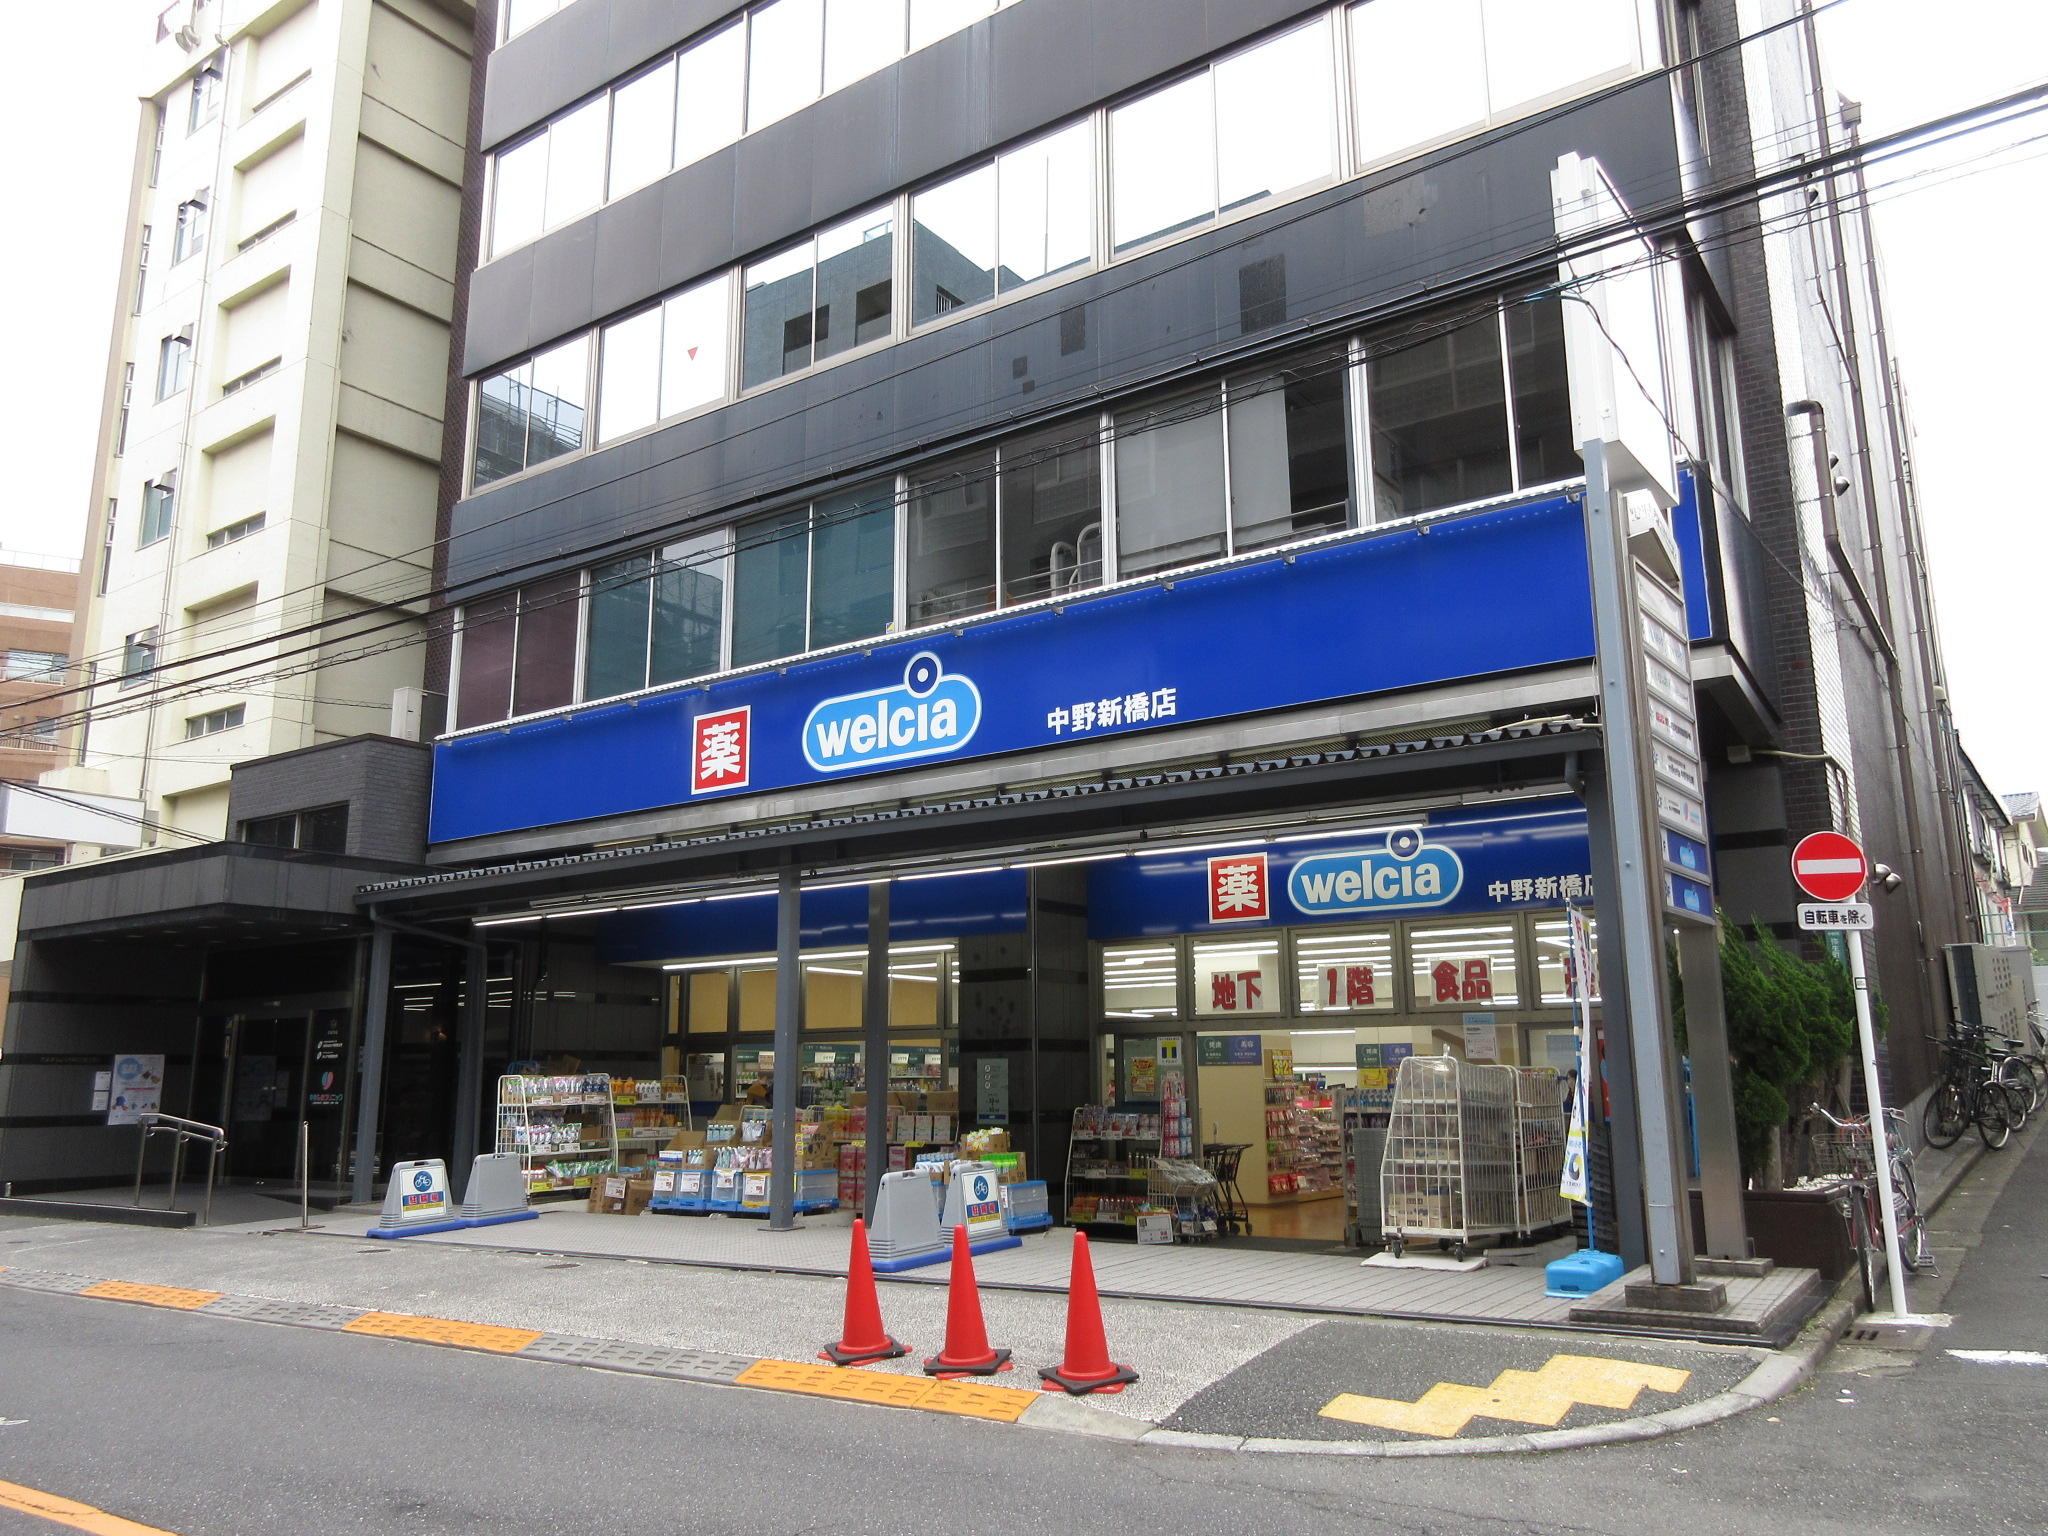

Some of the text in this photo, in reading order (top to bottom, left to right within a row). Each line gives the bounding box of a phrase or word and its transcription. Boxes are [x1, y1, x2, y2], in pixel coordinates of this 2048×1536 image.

[815, 698, 958, 759] welcia
[1047, 687, 1177, 736] 中野新橋店
[700, 720, 742, 781] 薬
[1216, 864, 1260, 912] 薬
[1300, 859, 1441, 904] welcia
[1804, 909, 1867, 925] 自転車を除く
[1212, 971, 1262, 1010] 地下
[1327, 966, 1375, 1006] 1階
[1431, 959, 1493, 1003] 食品
